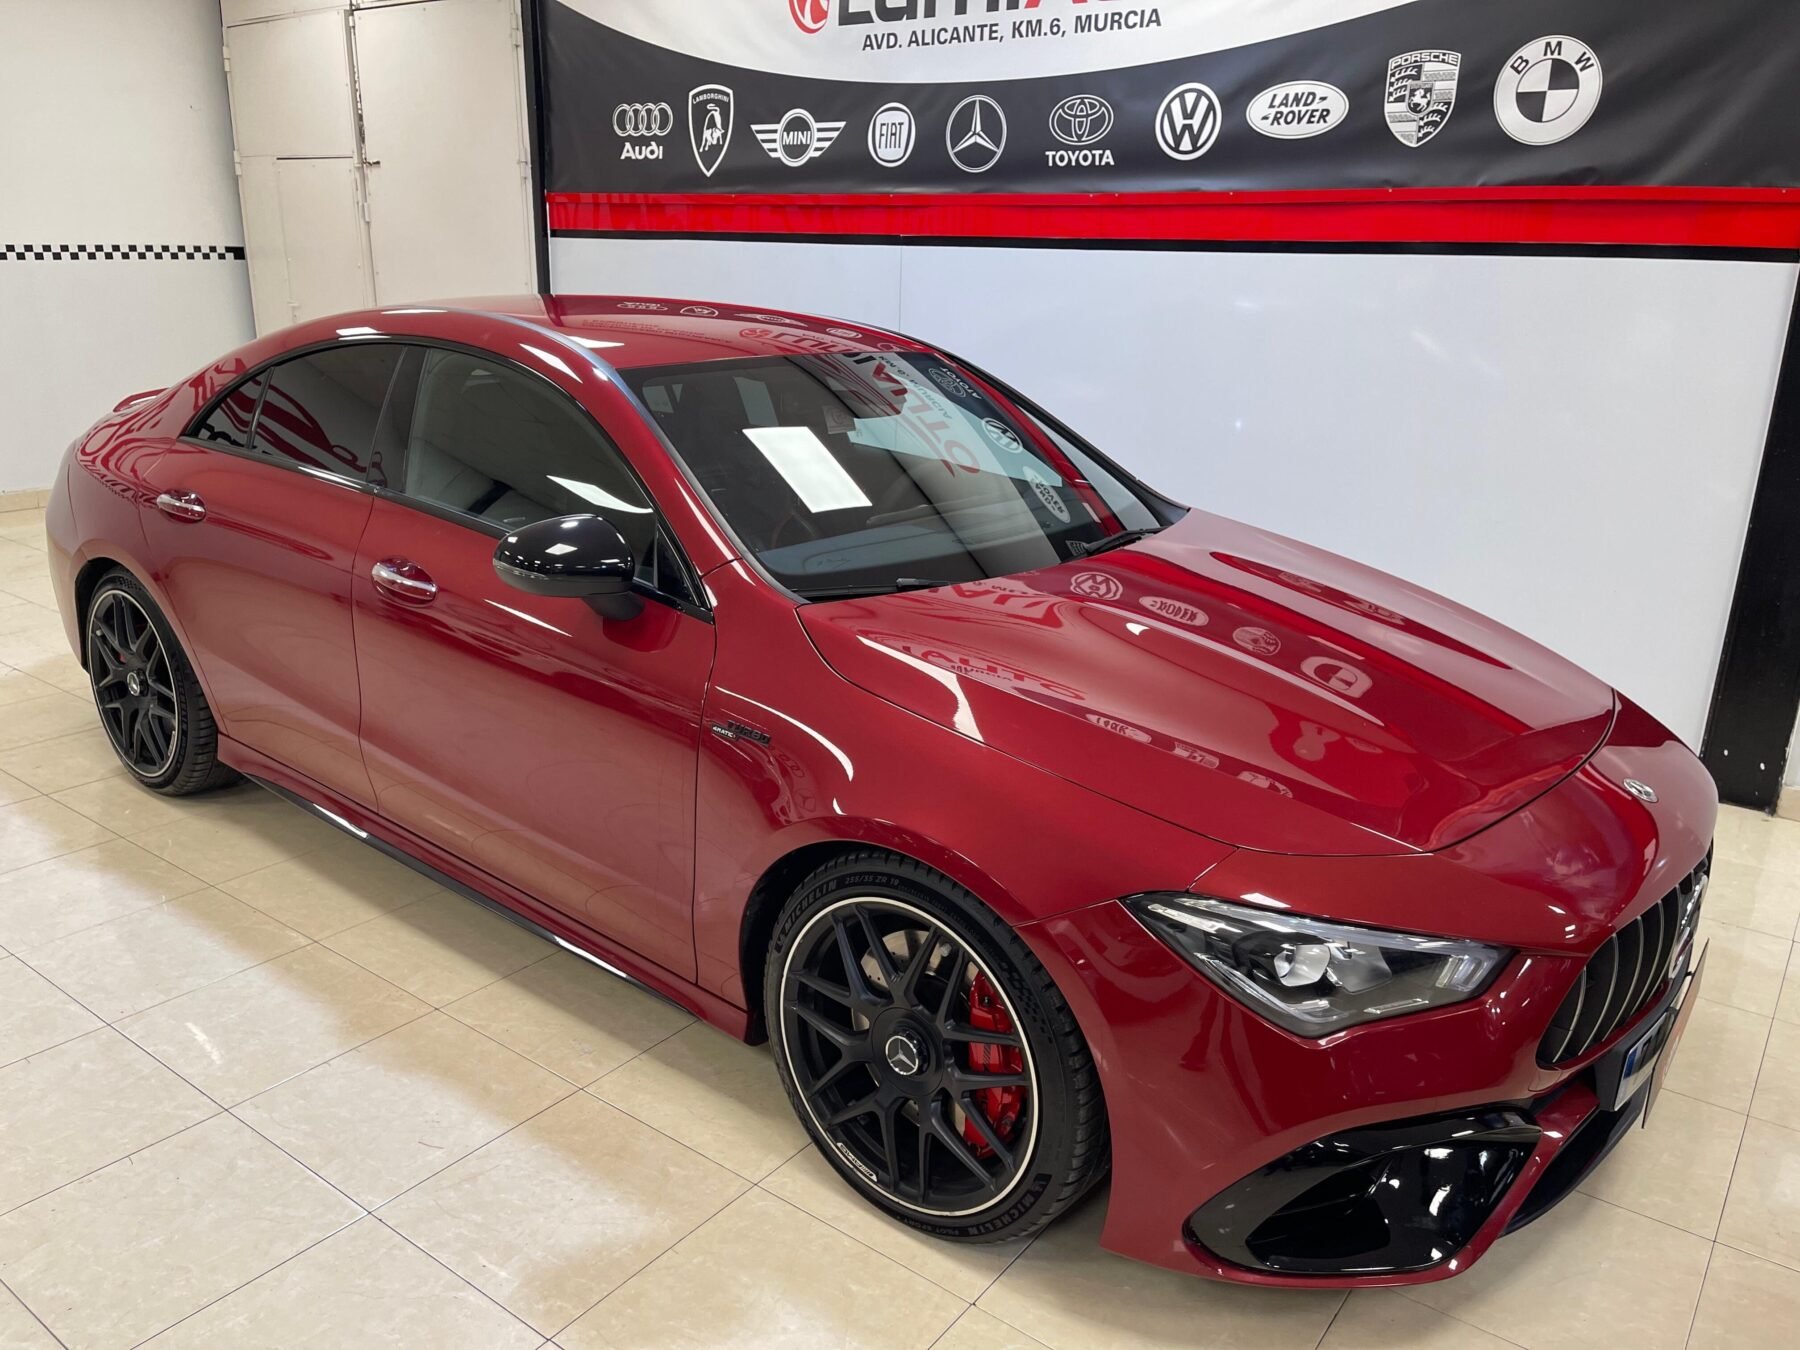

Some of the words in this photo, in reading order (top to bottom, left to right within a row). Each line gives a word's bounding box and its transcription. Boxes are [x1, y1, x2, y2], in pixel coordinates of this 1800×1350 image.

[862, 32, 902, 51] AVD.
[907, 23, 1004, 49] ALICANTE,
[1011, 17, 1066, 40] KM.6,
[1073, 8, 1162, 34] MURCIA
[1391, 52, 1458, 69] PORSCHE
[692, 93, 730, 104] LAMBORGHINI
[782, 130, 811, 145] MINI
[879, 121, 904, 149] FIAT
[620, 141, 663, 160] Audi
[1045, 149, 1115, 167] TOYOTA
[784, 878, 838, 931] MICHELIN
[968, 1188, 1036, 1236] MICHELIN
